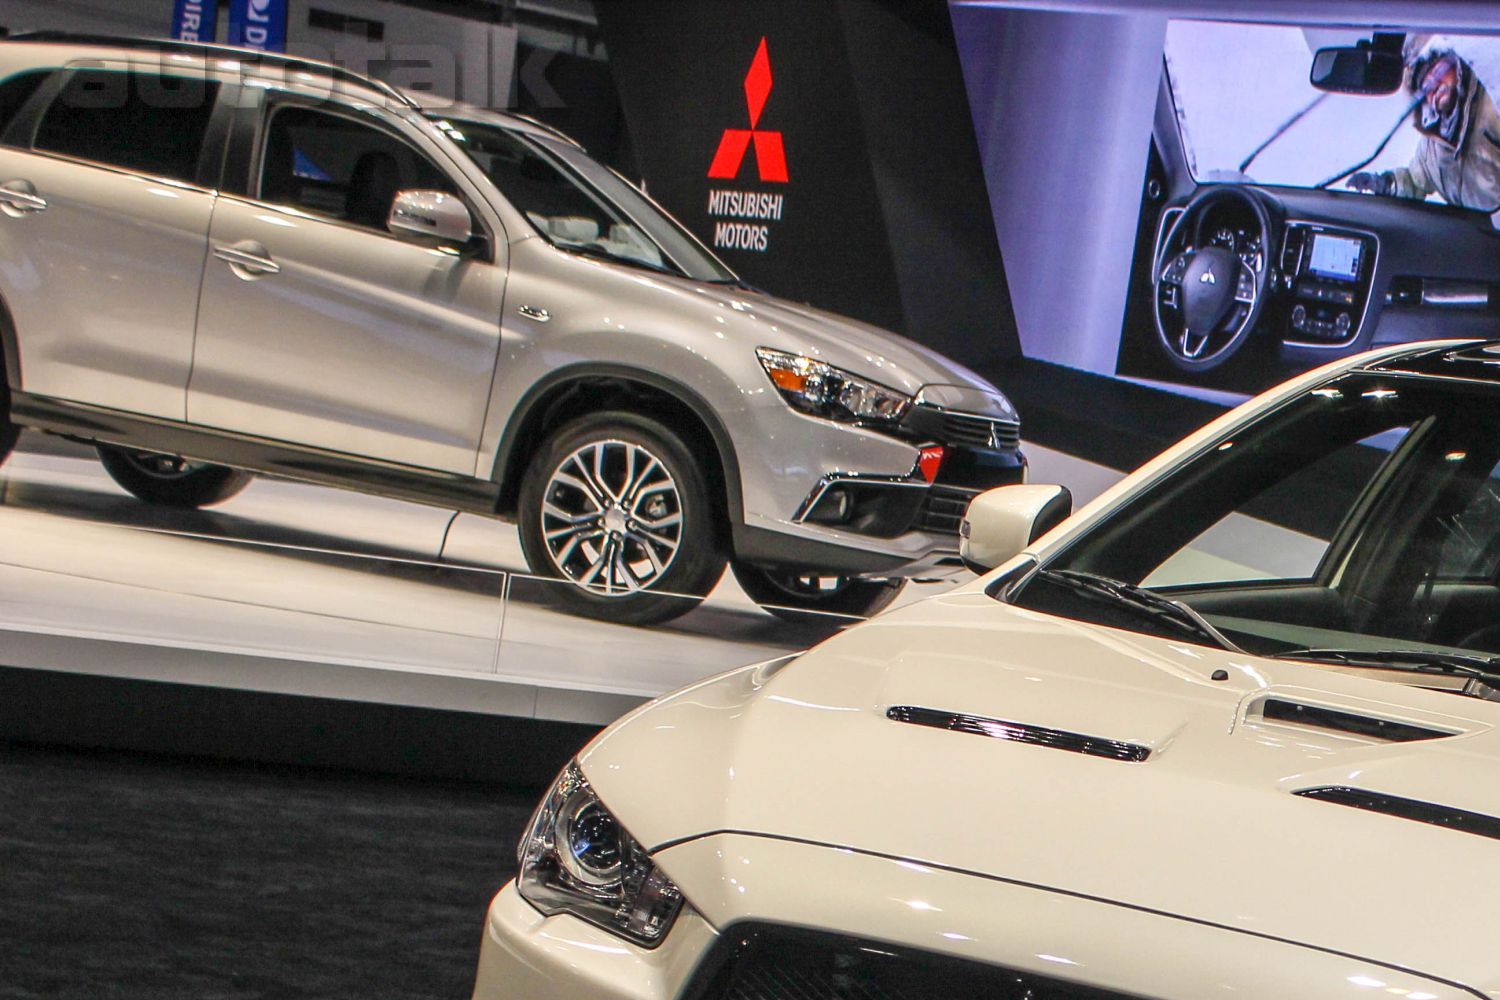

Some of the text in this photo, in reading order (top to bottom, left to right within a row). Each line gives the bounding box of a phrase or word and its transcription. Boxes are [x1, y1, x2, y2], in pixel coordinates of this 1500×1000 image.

[181, 0, 202, 43] IRE
[708, 190, 783, 220] MITSUBISHI
[714, 222, 768, 252] MOTORS
